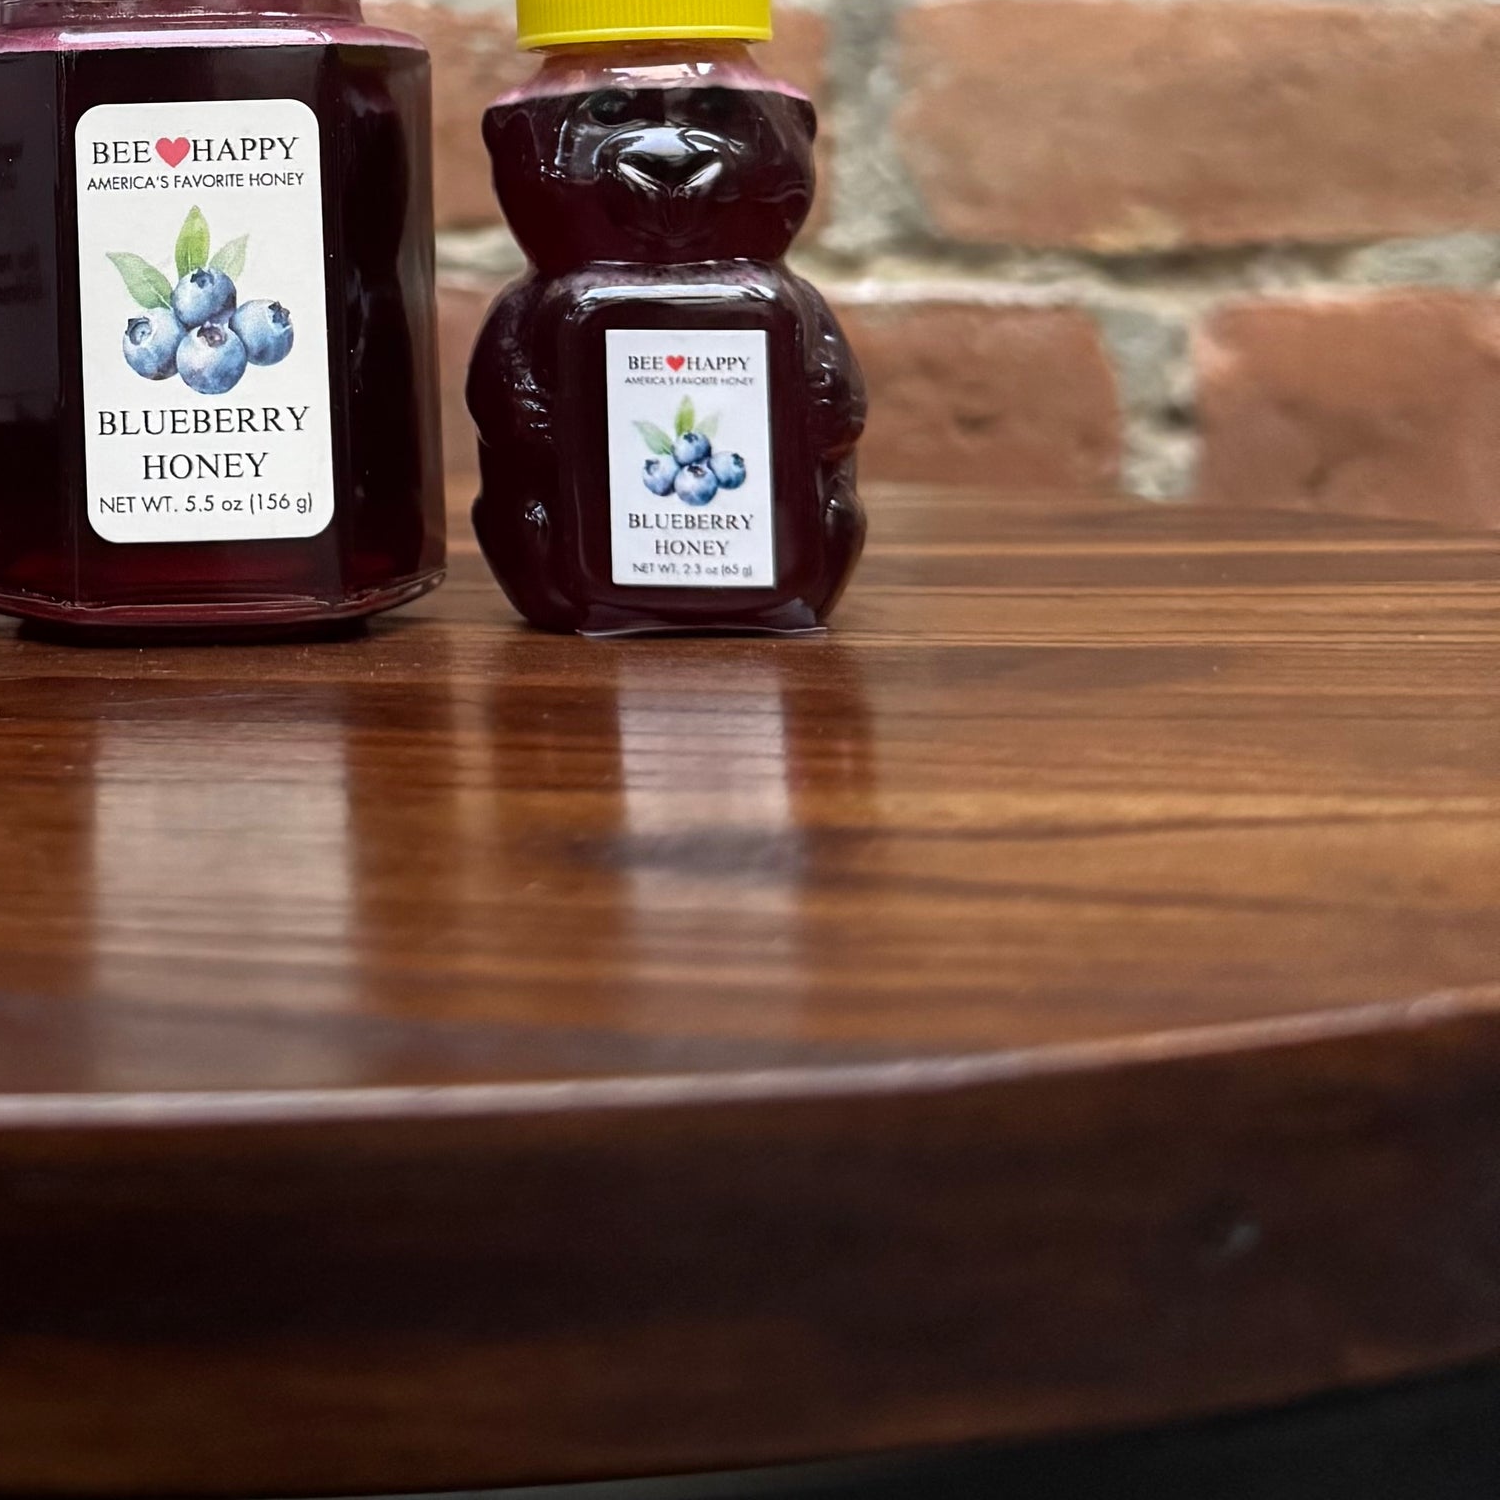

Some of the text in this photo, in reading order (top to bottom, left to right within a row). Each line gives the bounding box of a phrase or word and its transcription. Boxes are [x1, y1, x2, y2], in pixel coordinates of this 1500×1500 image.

[92, 136, 299, 165] BEE HAPPY
[87, 172, 304, 191] AMERICA'S FAVORITE HONEY
[628, 355, 750, 371] BEE HAPPY
[98, 406, 310, 436] BLUEBERRY
[142, 452, 268, 481] HONEY
[99, 492, 313, 515] NET WT. 5.5 oz (156 g)
[628, 513, 754, 530] BLUEBERRY
[655, 540, 729, 555] HONEY
[632, 562, 655, 575] NET
[705, 566, 718, 575] oz
